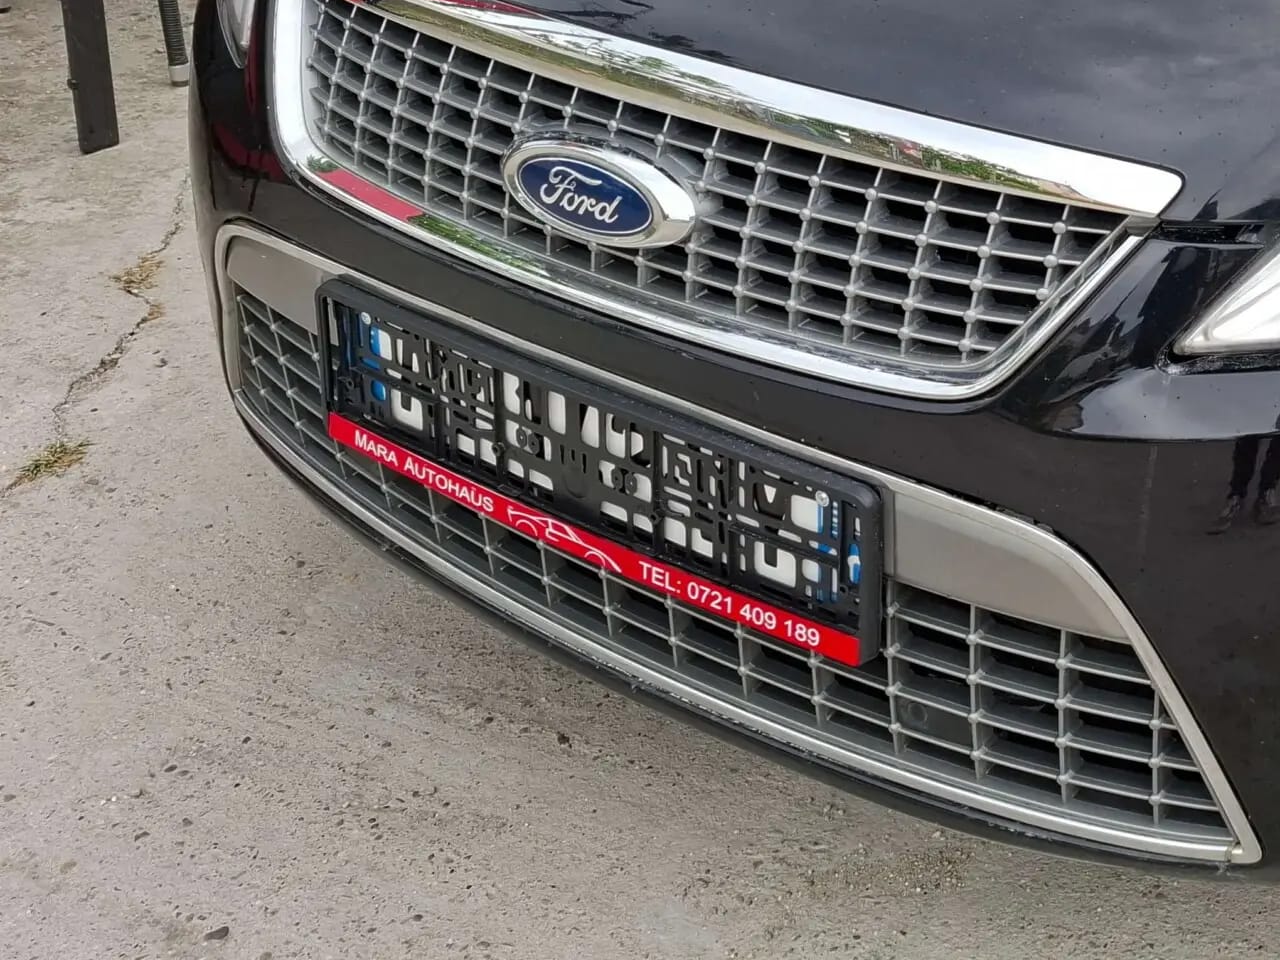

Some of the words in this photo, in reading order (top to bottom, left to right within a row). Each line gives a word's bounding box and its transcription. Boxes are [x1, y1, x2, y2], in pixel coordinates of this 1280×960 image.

[540, 166, 623, 224] Ford
[354, 429, 398, 466] MARA
[404, 457, 494, 512] AUTOHAUS
[638, 561, 682, 594] TEL:
[687, 582, 733, 614] 0721
[739, 603, 777, 631] 409
[784, 620, 820, 647] 189
